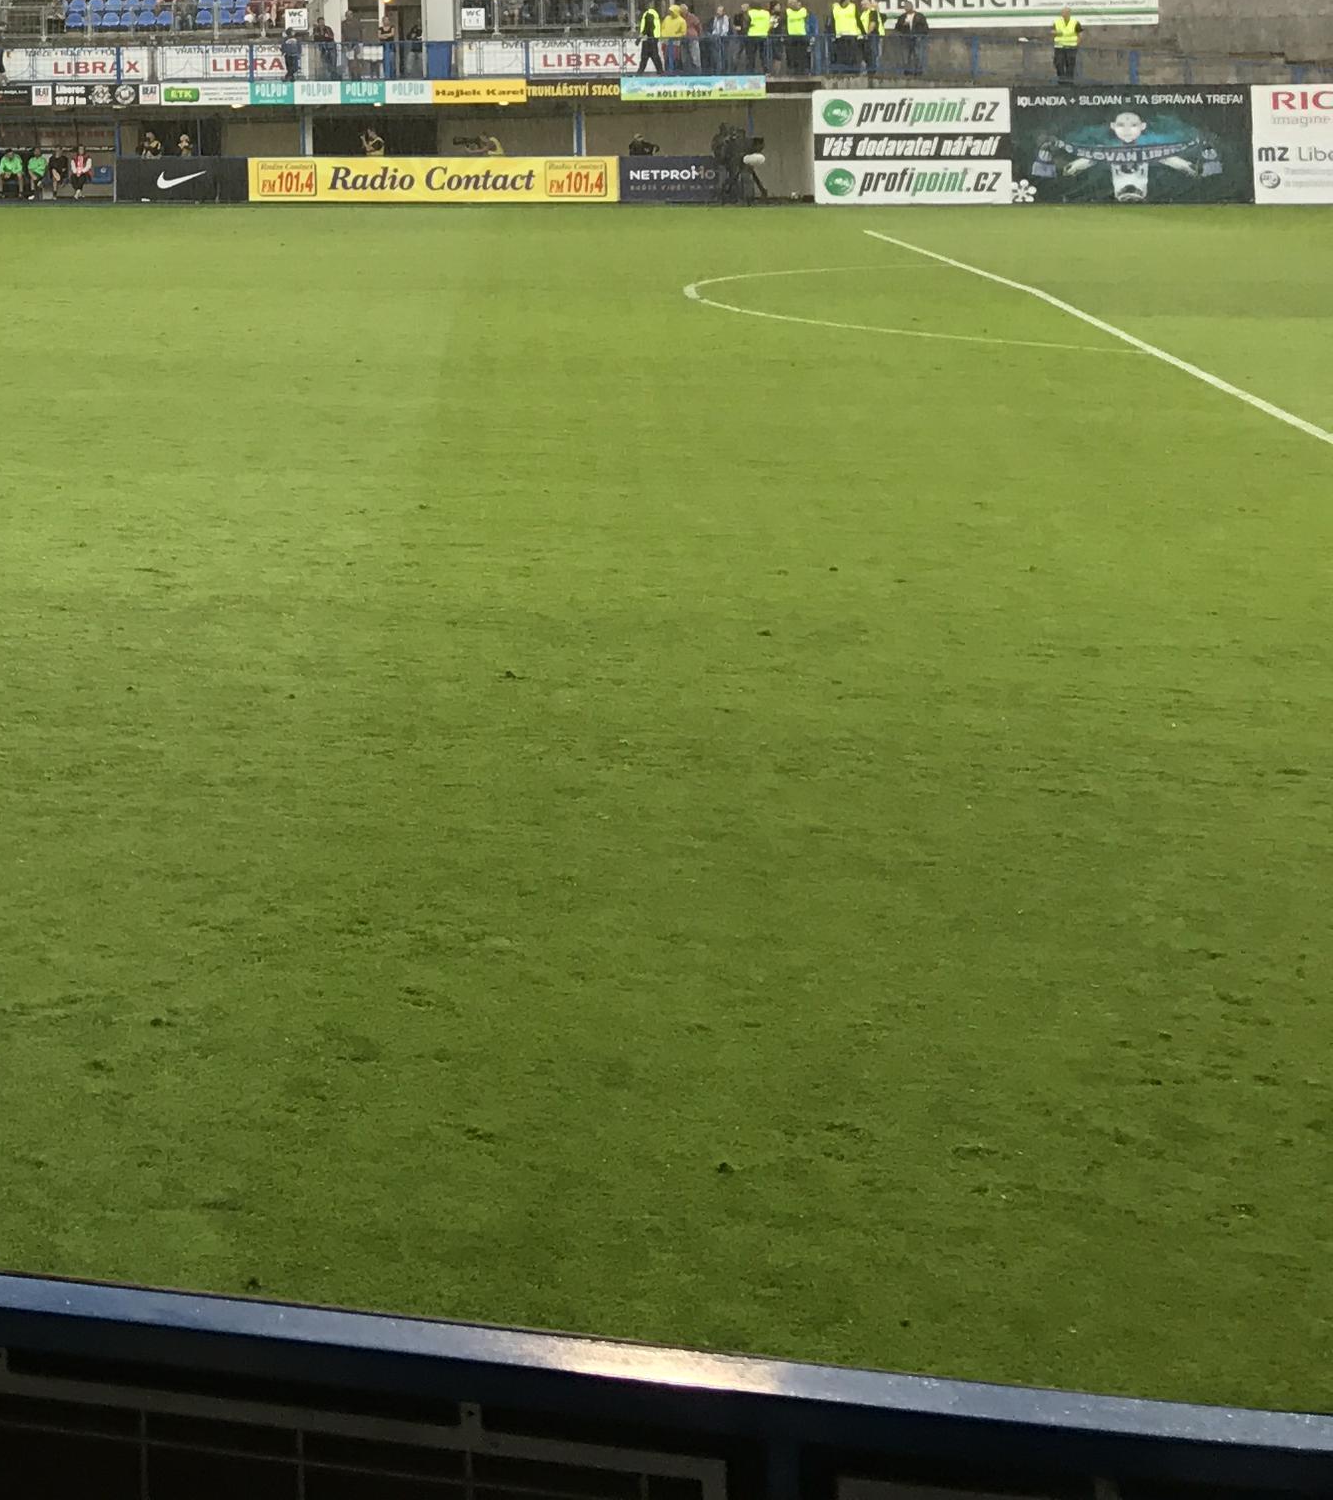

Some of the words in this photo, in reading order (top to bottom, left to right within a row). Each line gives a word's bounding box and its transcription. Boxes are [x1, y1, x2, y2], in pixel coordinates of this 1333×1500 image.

[53, 60, 140, 74] LIBRAX
[212, 57, 284, 72] LIBRA
[542, 53, 638, 68] LIBRAX
[527, 82, 589, 97] TRUHLÁŘSTVÍ
[1017, 95, 1067, 107] IQLANDIA
[1079, 94, 1122, 105] SLOVAN
[1134, 94, 1148, 105] TA
[1151, 93, 1204, 104] SPRÁVNÁ
[1206, 94, 1244, 104] TREFA!
[856, 97, 1000, 127] profipoint.cz
[822, 137, 854, 157] Váš
[855, 136, 937, 157] dodavatel
[940, 135, 1001, 156] nářadí
[328, 166, 415, 191] Radio
[425, 166, 536, 191] Contact
[549, 179, 565, 192] FM
[565, 171, 604, 193] 101,4
[629, 165, 716, 181] NETPROMO
[858, 167, 1003, 197] profipoint.cz
[261, 180, 277, 192] FM
[277, 172, 314, 193] 101,4
